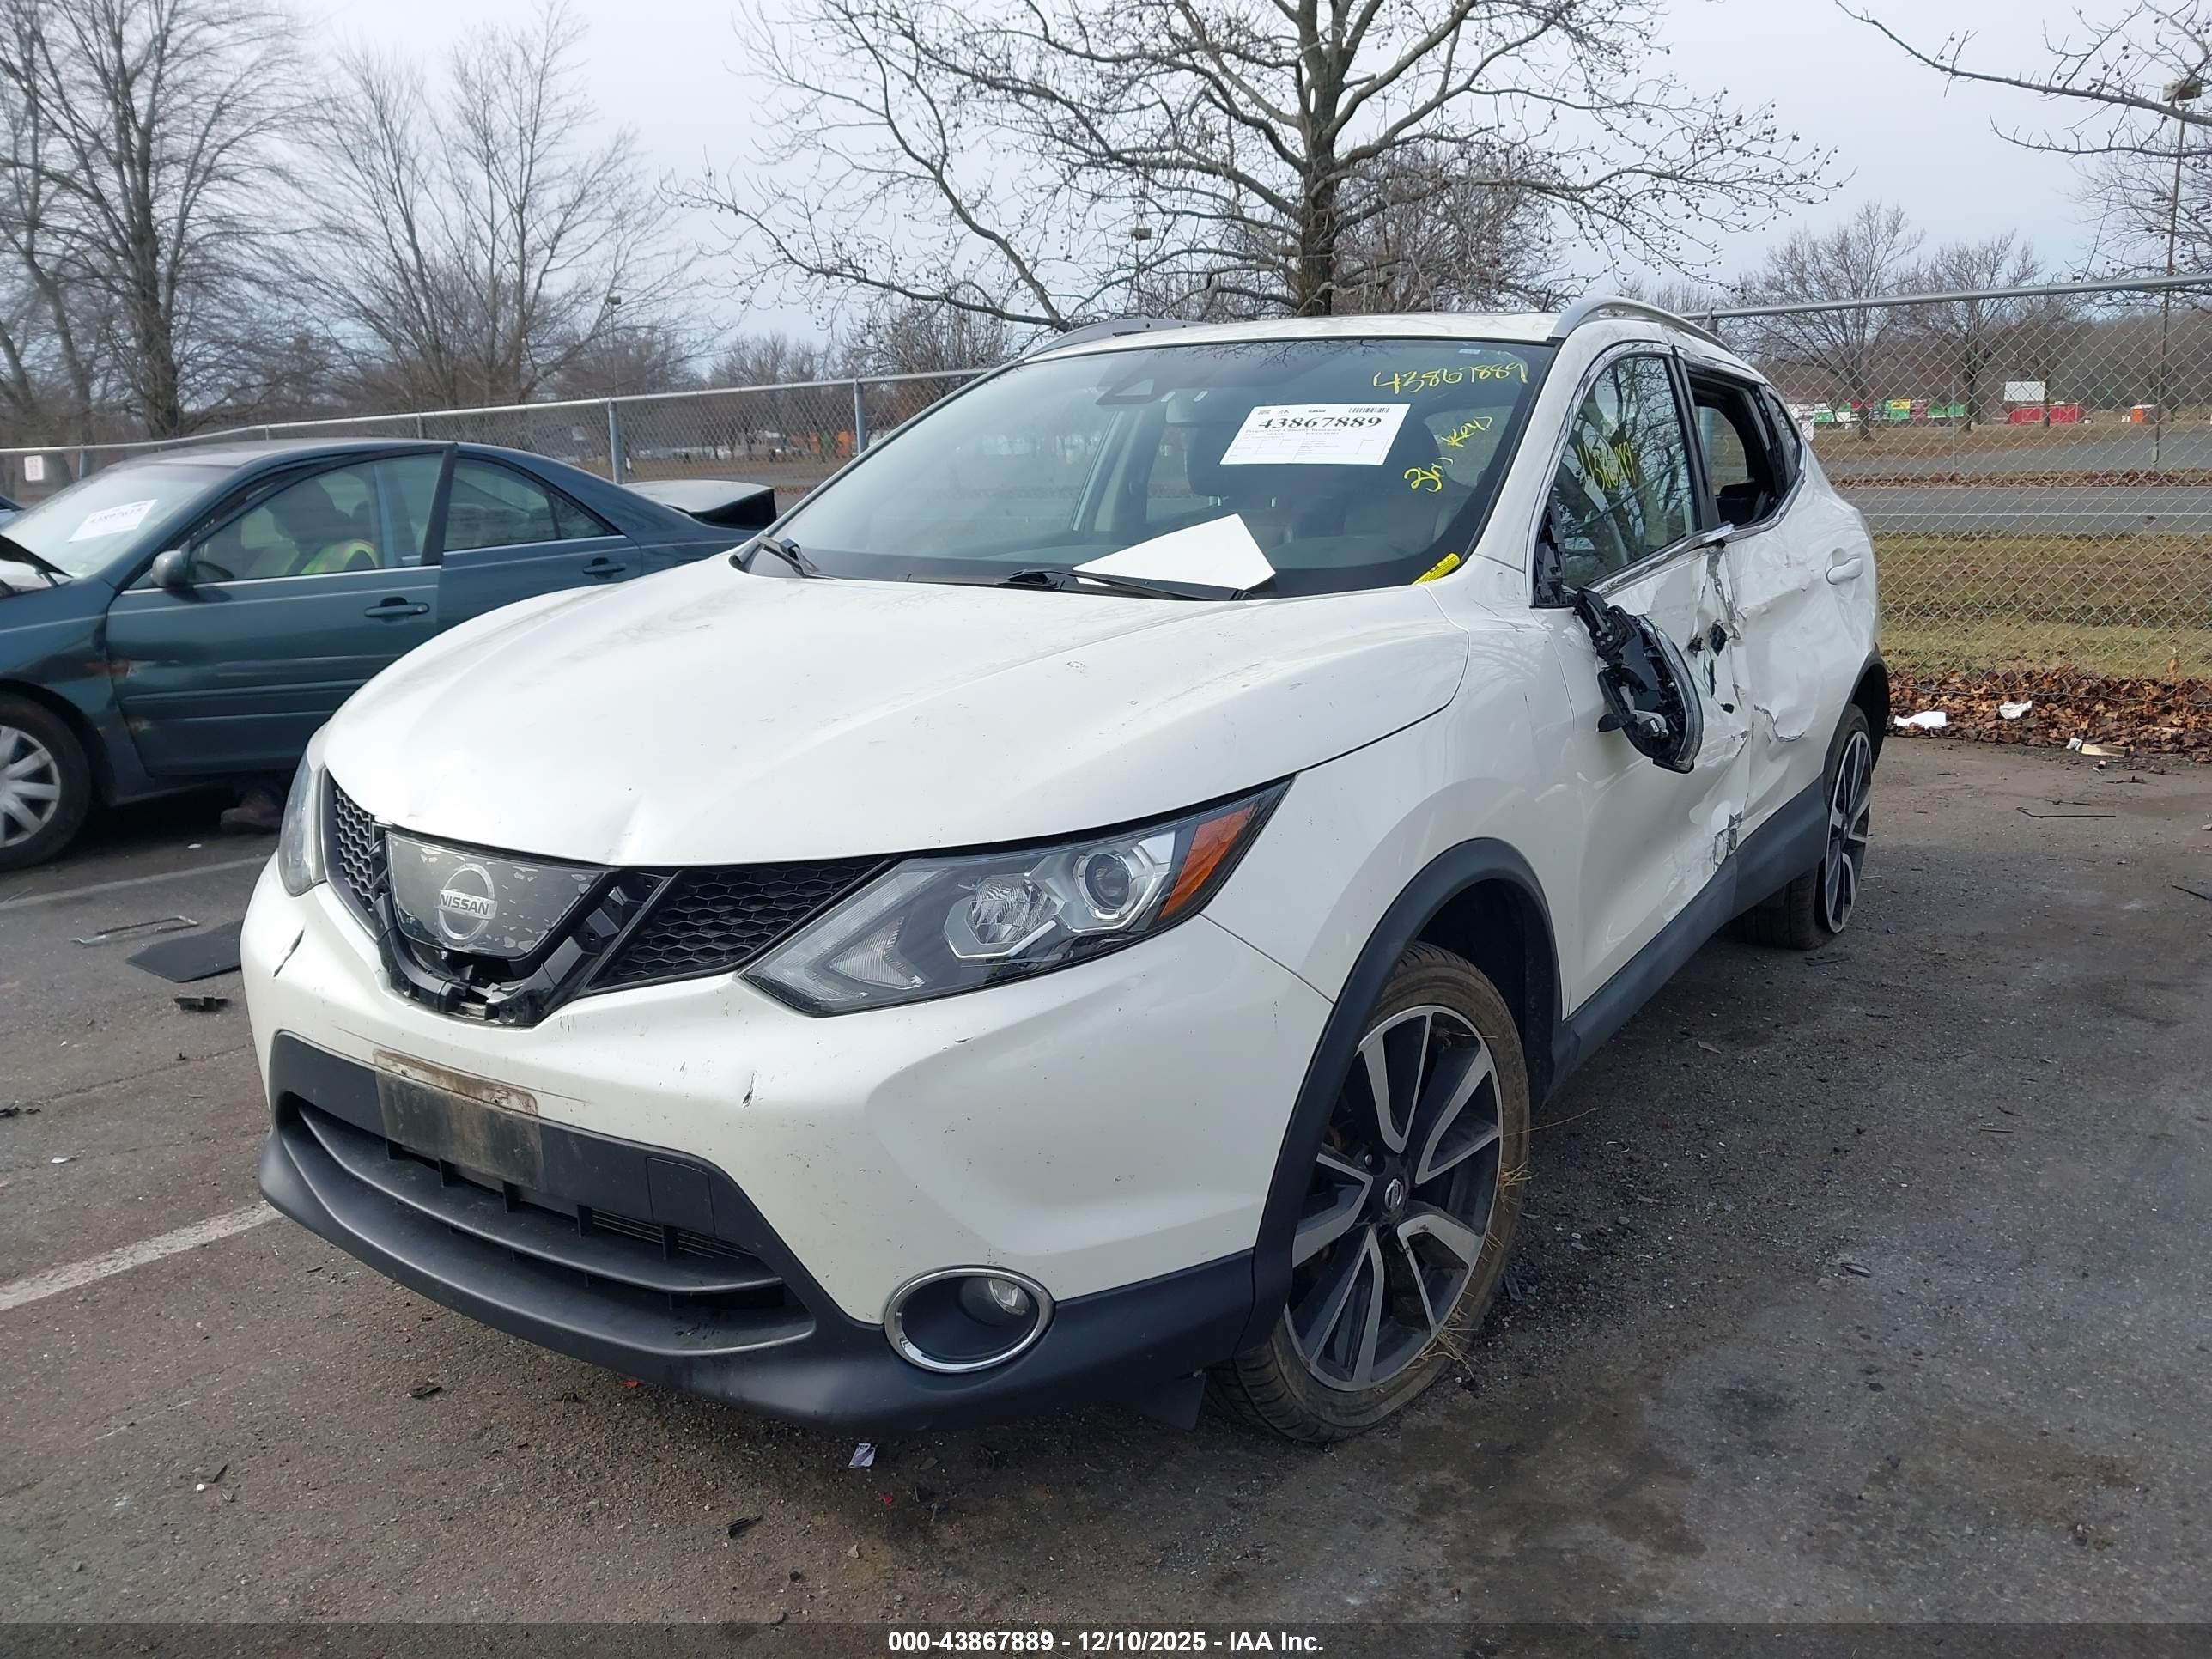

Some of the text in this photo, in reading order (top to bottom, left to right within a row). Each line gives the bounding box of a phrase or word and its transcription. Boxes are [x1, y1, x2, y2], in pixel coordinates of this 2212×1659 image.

[1373, 362, 1529, 394] 43867889
[1258, 416, 1382, 428] 43867889
[439, 893, 489, 915] NISSAN
